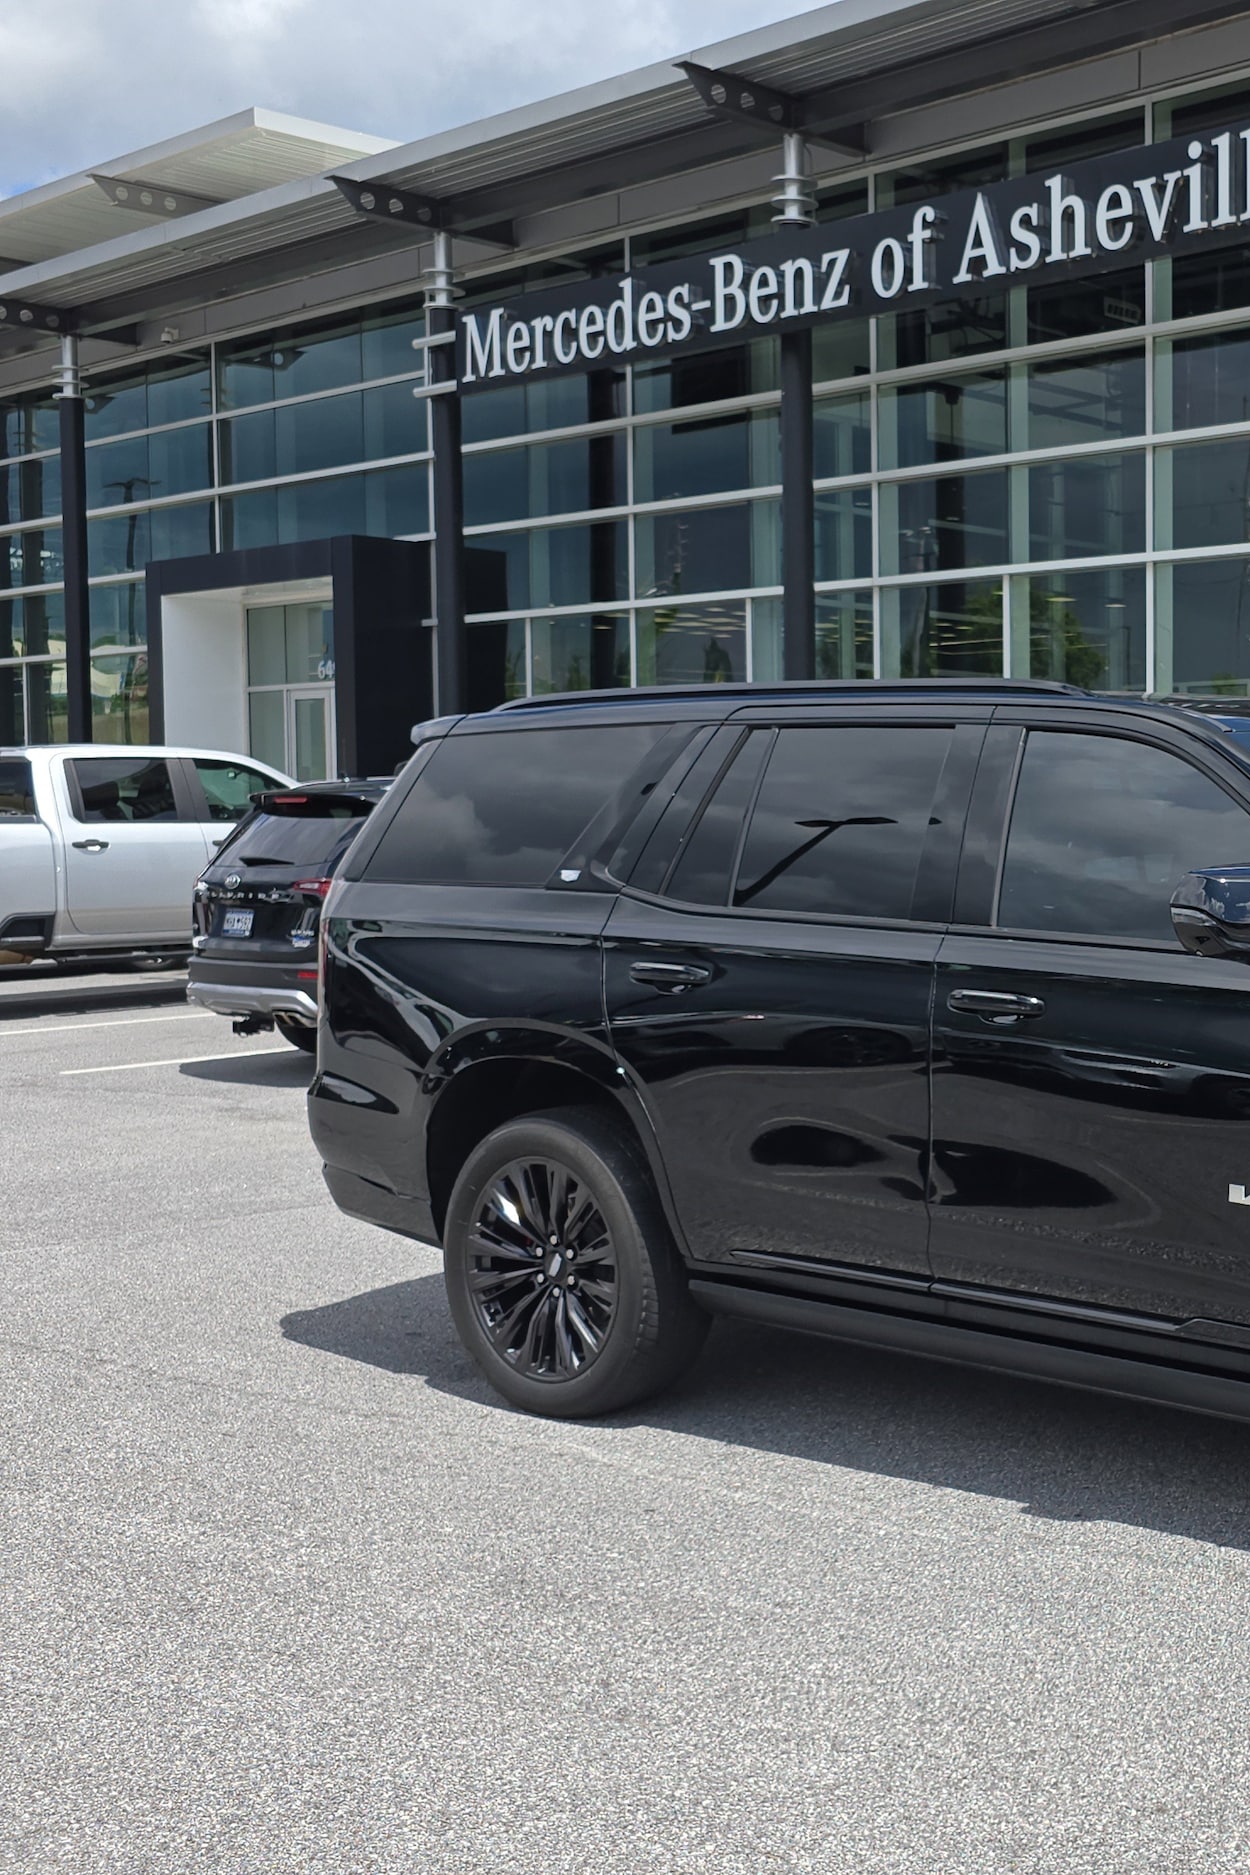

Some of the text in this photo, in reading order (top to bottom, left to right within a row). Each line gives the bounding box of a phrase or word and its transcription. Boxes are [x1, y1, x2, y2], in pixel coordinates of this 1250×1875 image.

[461, 248, 851, 384] Mercedes-Benz
[870, 204, 936, 299] of
[318, 660, 336, 680] 64
